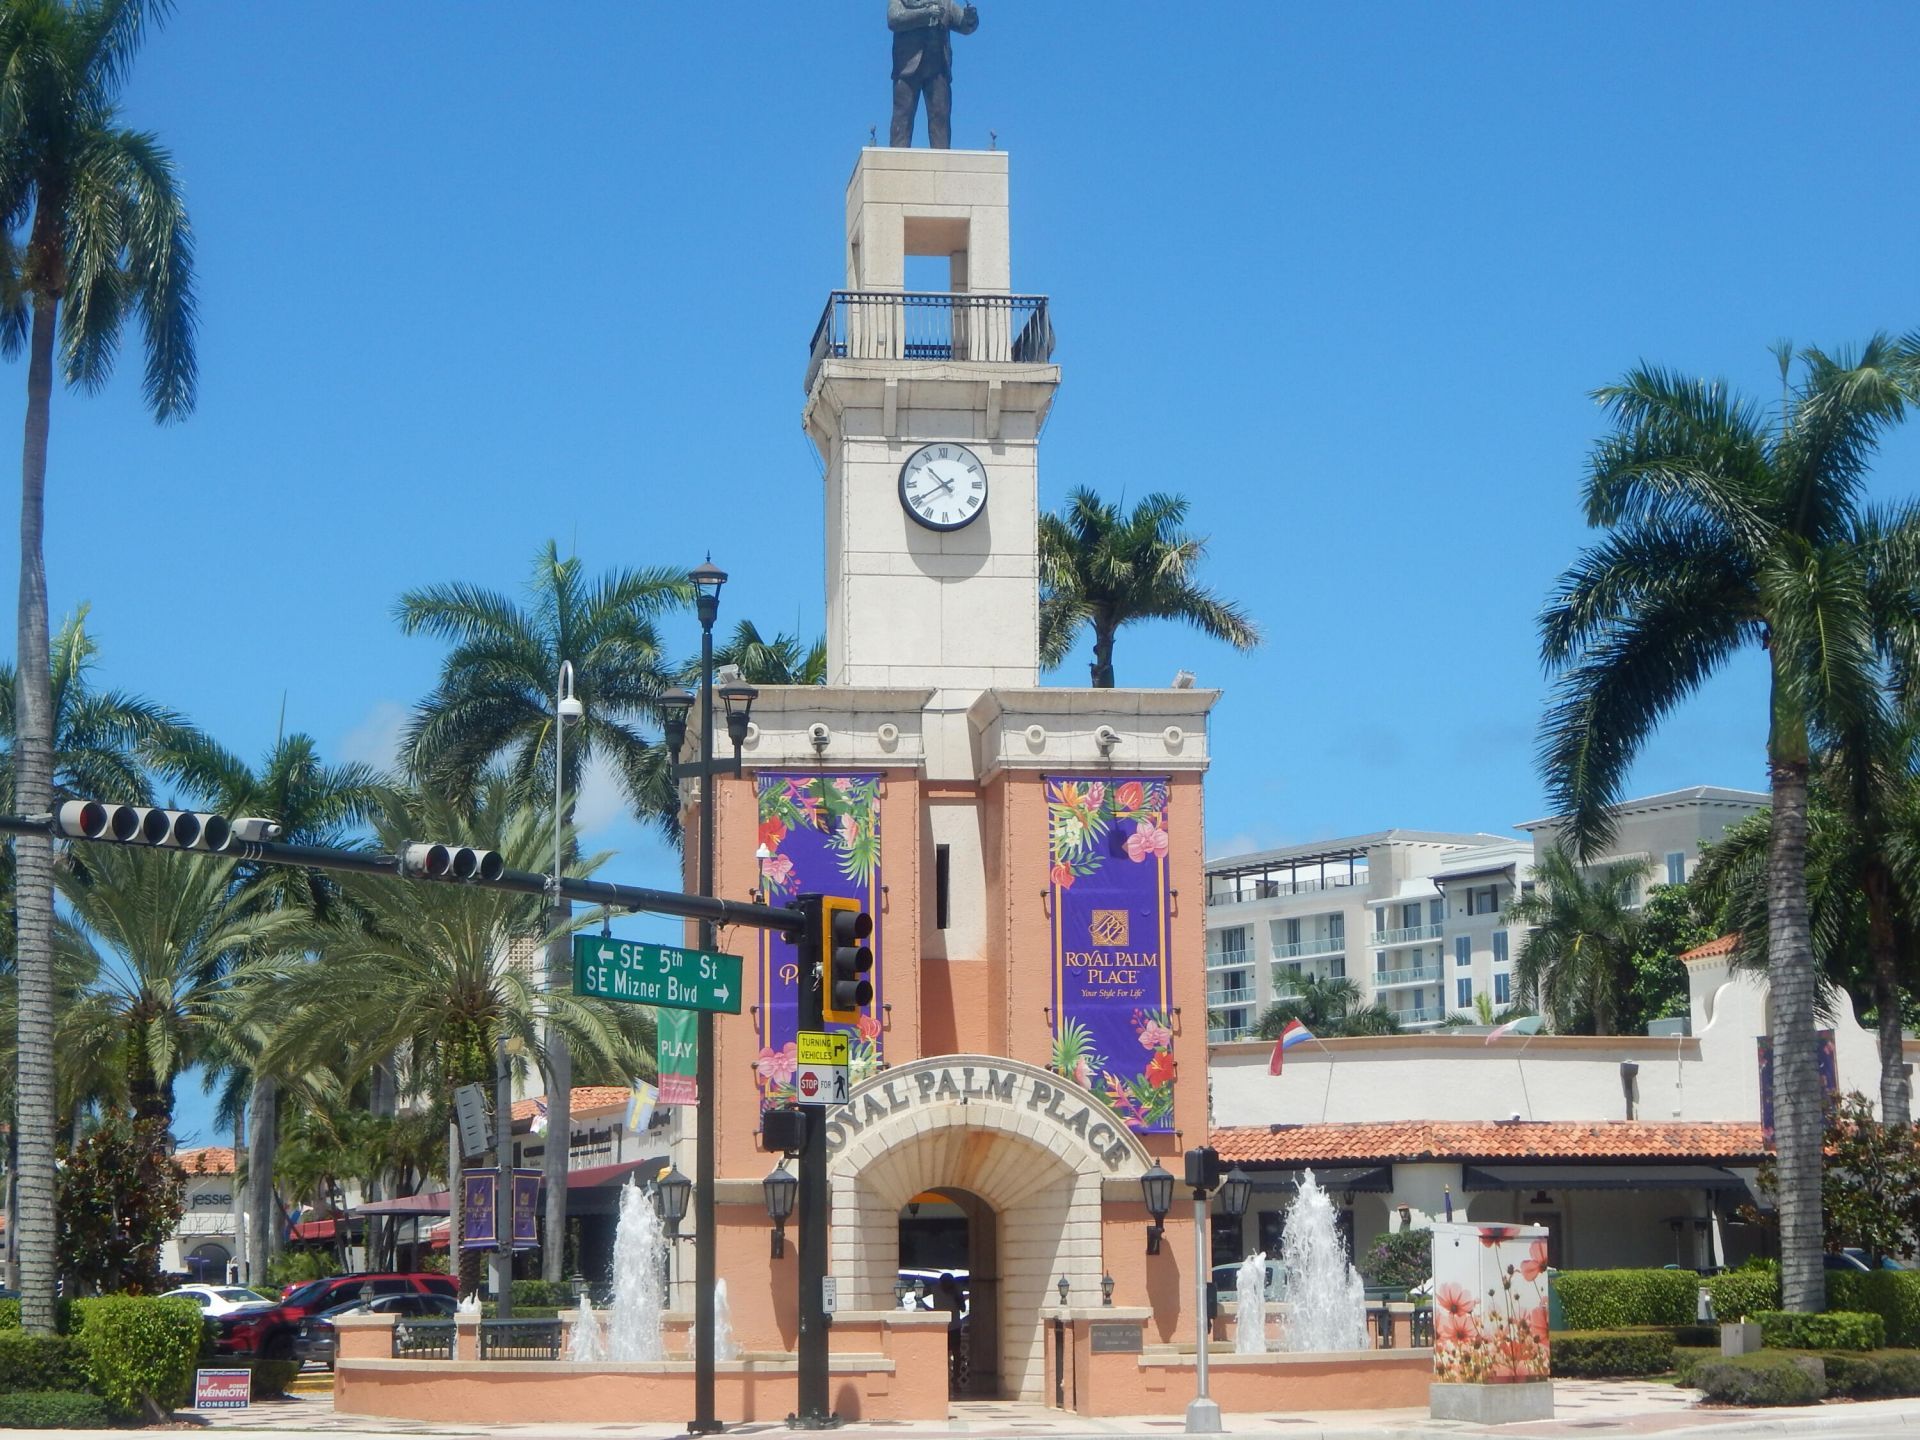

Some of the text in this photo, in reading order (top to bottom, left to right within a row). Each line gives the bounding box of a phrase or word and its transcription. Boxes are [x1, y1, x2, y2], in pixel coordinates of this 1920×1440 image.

[620, 944, 718, 980] SE 5th St
[1065, 950, 1158, 967] ROYAL PALM
[586, 966, 697, 1003] SE Mizner Blvd
[1081, 989, 1098, 997] Your
[1098, 989, 1116, 999] Style
[1117, 990, 1129, 998] For
[661, 1040, 692, 1058] PLAY
[802, 1038, 832, 1048] TURNING
[800, 1050, 832, 1060] VEHICLES
[801, 1080, 832, 1089] STOP FOR
[826, 1067, 1131, 1172] OYAL PALM PLACE
[190, 1193, 232, 1210] jessie
[198, 1388, 248, 1397] WEINROTH
